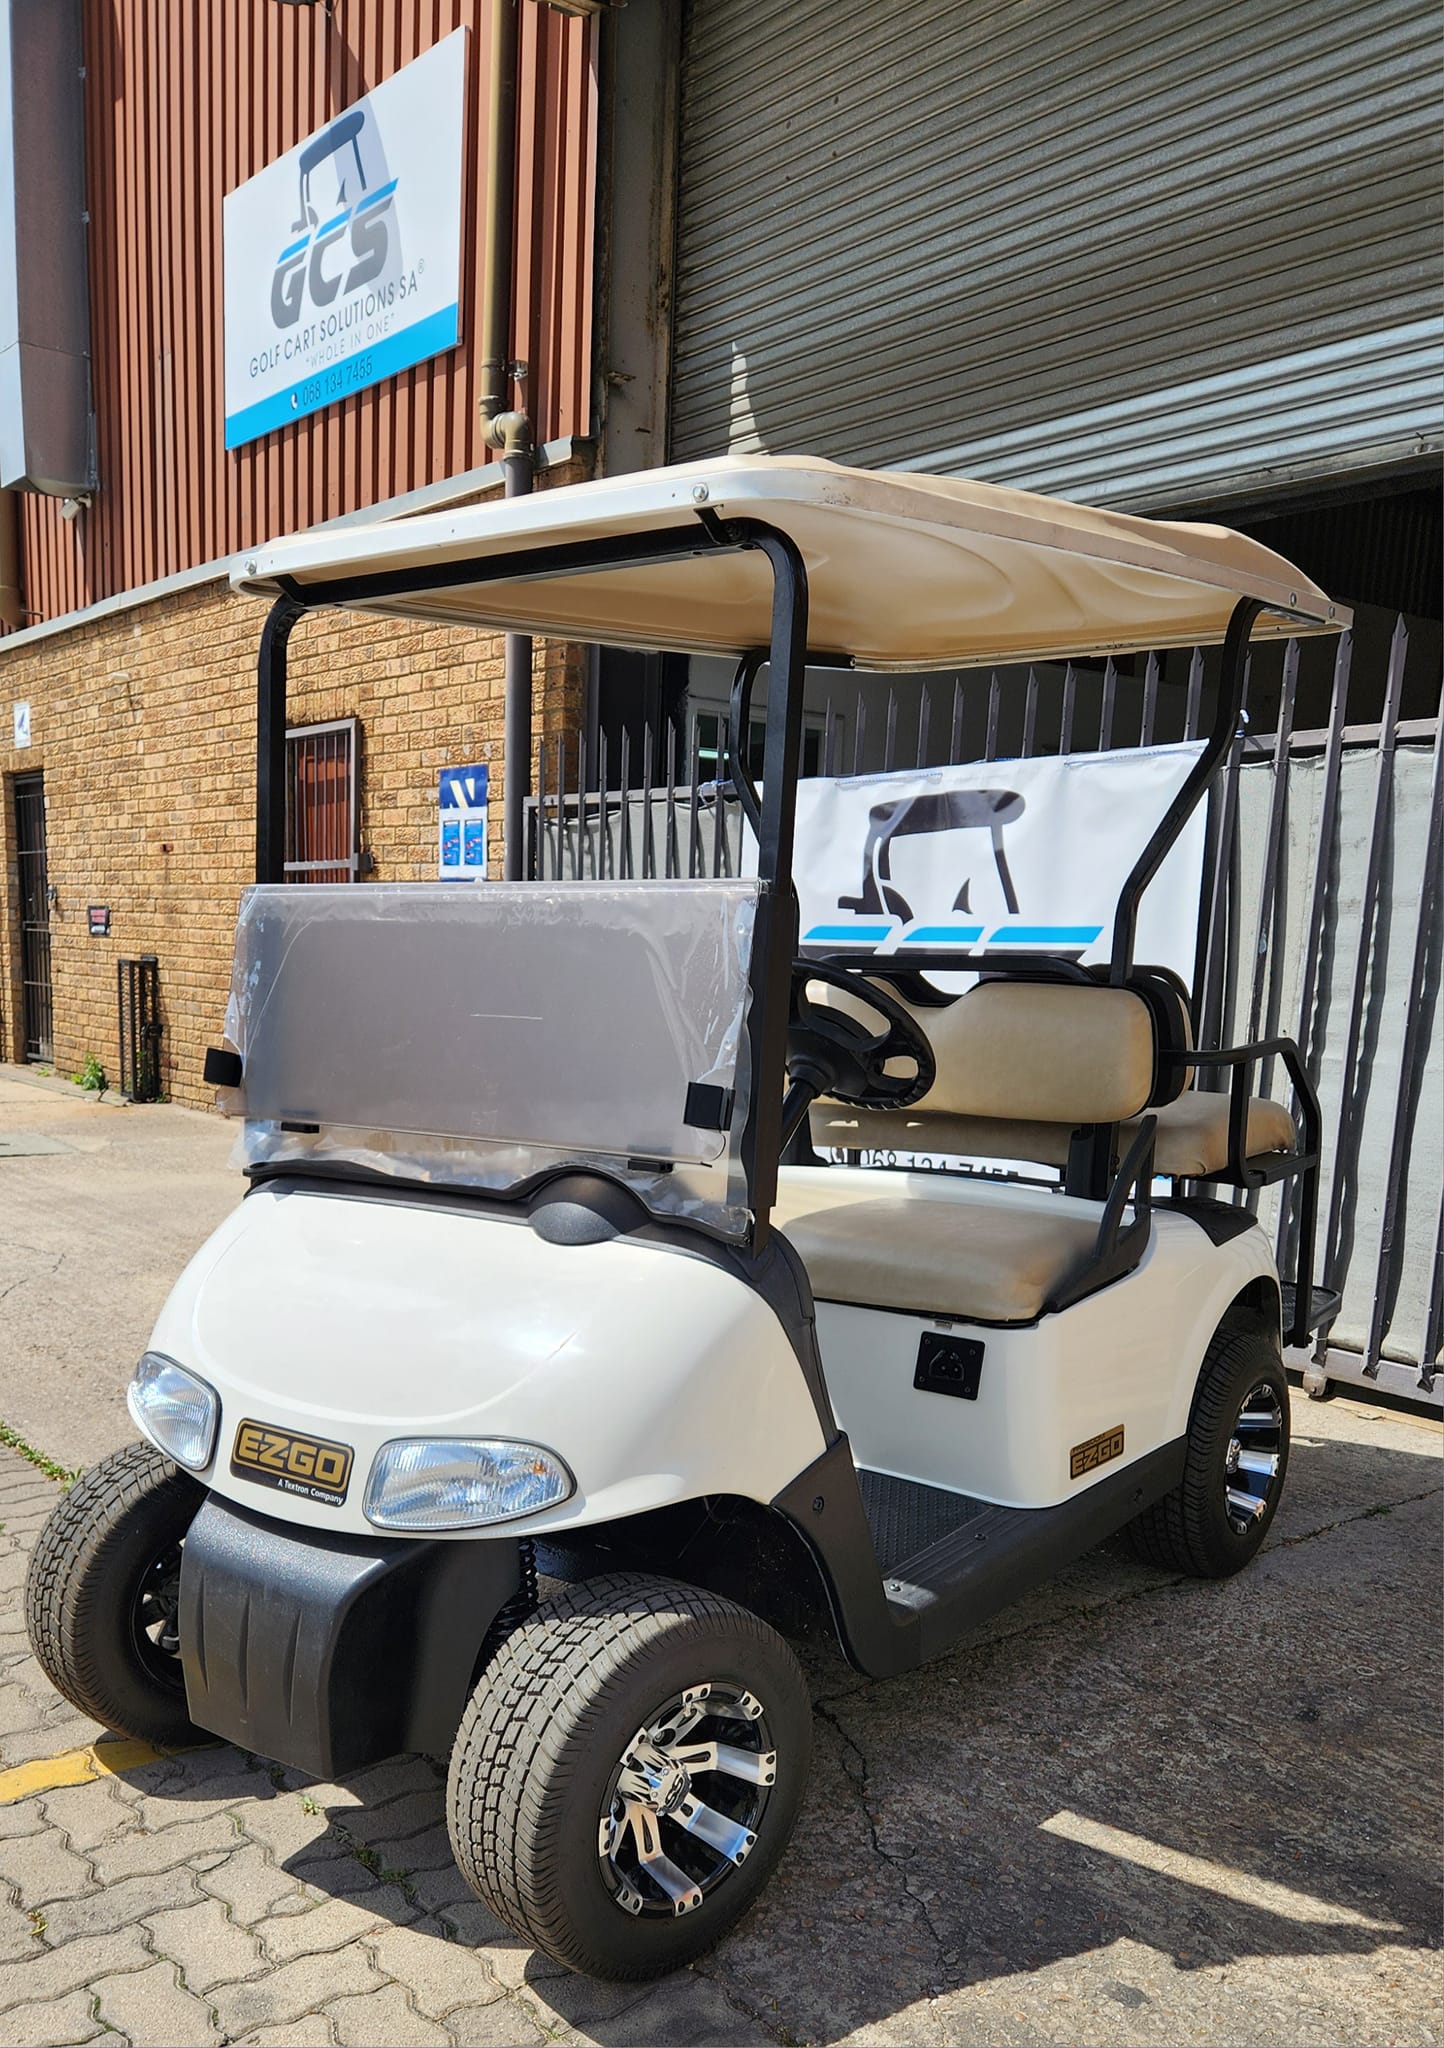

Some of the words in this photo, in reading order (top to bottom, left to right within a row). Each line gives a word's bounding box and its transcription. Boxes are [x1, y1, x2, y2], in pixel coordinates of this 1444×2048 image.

[270, 195, 394, 330] GCS
[249, 343, 281, 379] GOLF
[284, 323, 316, 360] CART
[320, 281, 395, 342] SOLUTIONS
[350, 331, 361, 349] IN
[302, 381, 322, 407] 068
[324, 369, 344, 396] 134
[345, 355, 374, 382] 7455
[277, 1477, 284, 1488] A
[284, 1480, 309, 1495] Textron
[310, 1487, 344, 1506] Company
